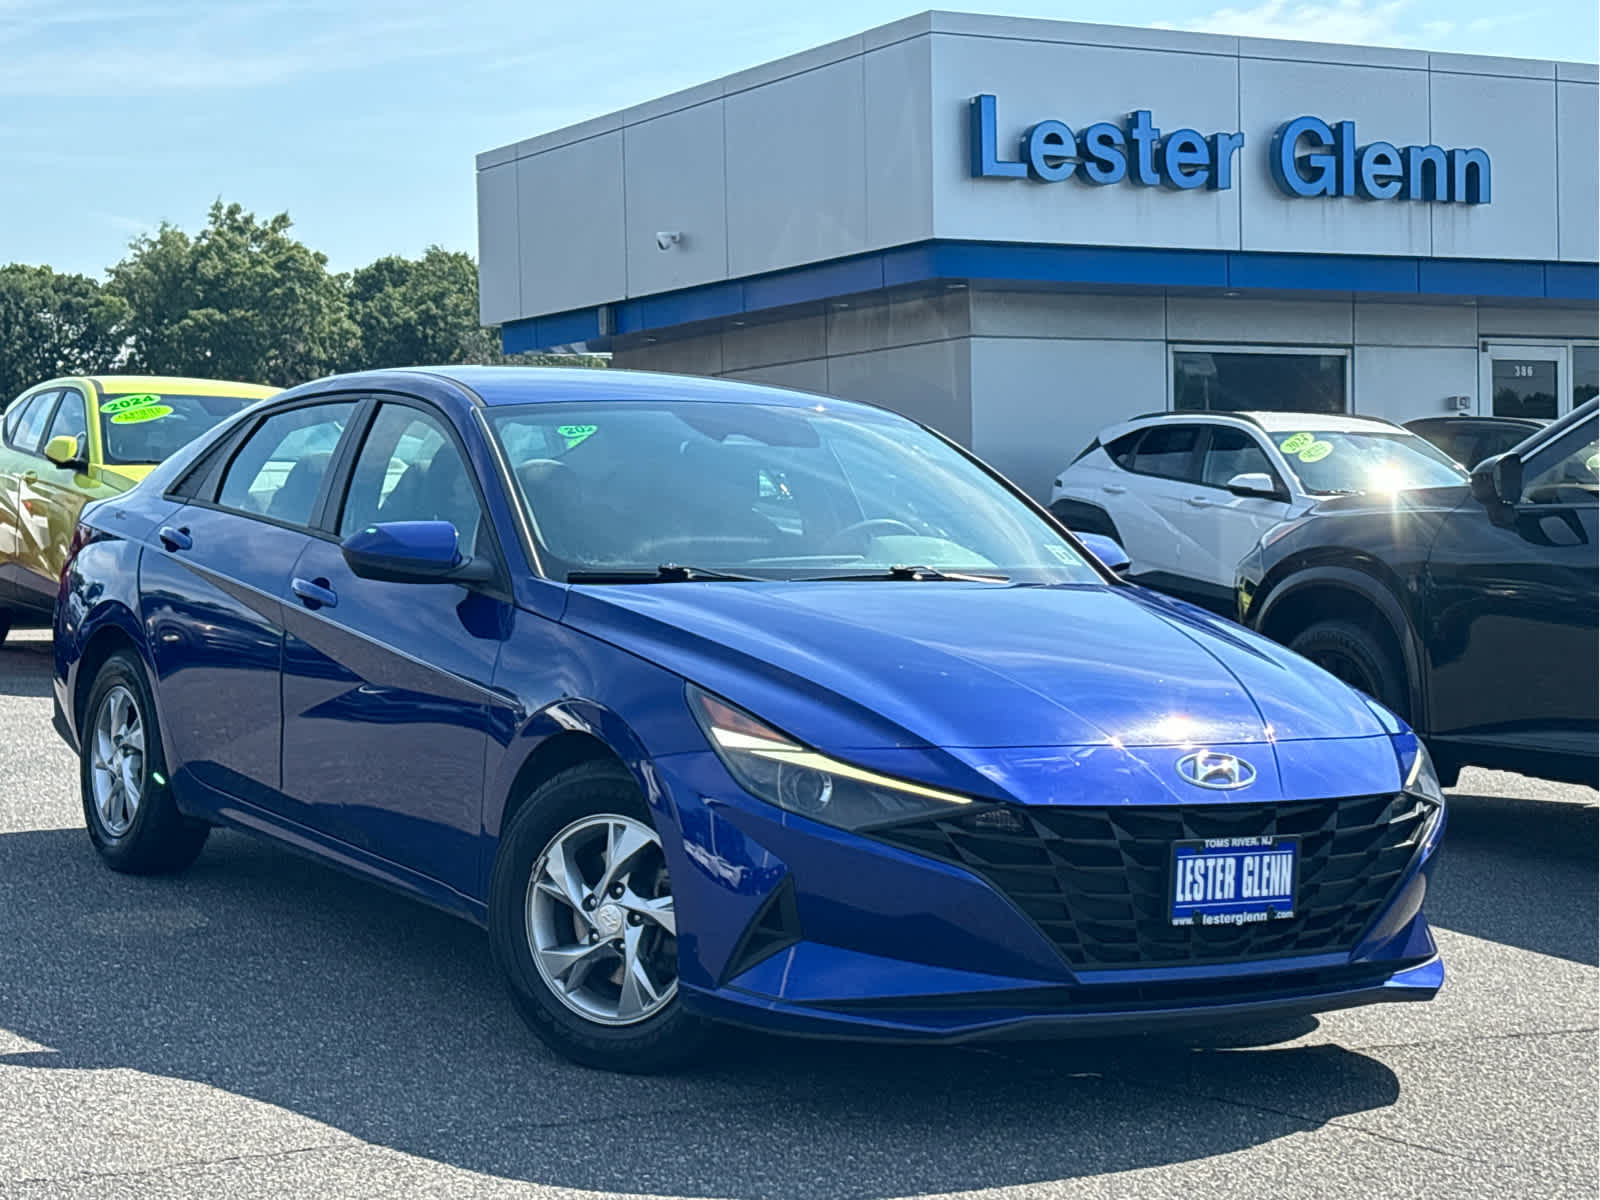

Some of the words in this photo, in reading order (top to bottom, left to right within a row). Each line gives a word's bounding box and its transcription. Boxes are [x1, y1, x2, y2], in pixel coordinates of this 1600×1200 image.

[970, 94, 1245, 191] Lester
[1270, 115, 1491, 205] Glenn
[107, 395, 155, 411] 2024
[1204, 839, 1230, 849] TOMS
[1261, 836, 1273, 846] NJ
[1176, 858, 1236, 902] LESTER
[1242, 855, 1293, 898] GLENN
[1202, 911, 1268, 926] lesterglenn
